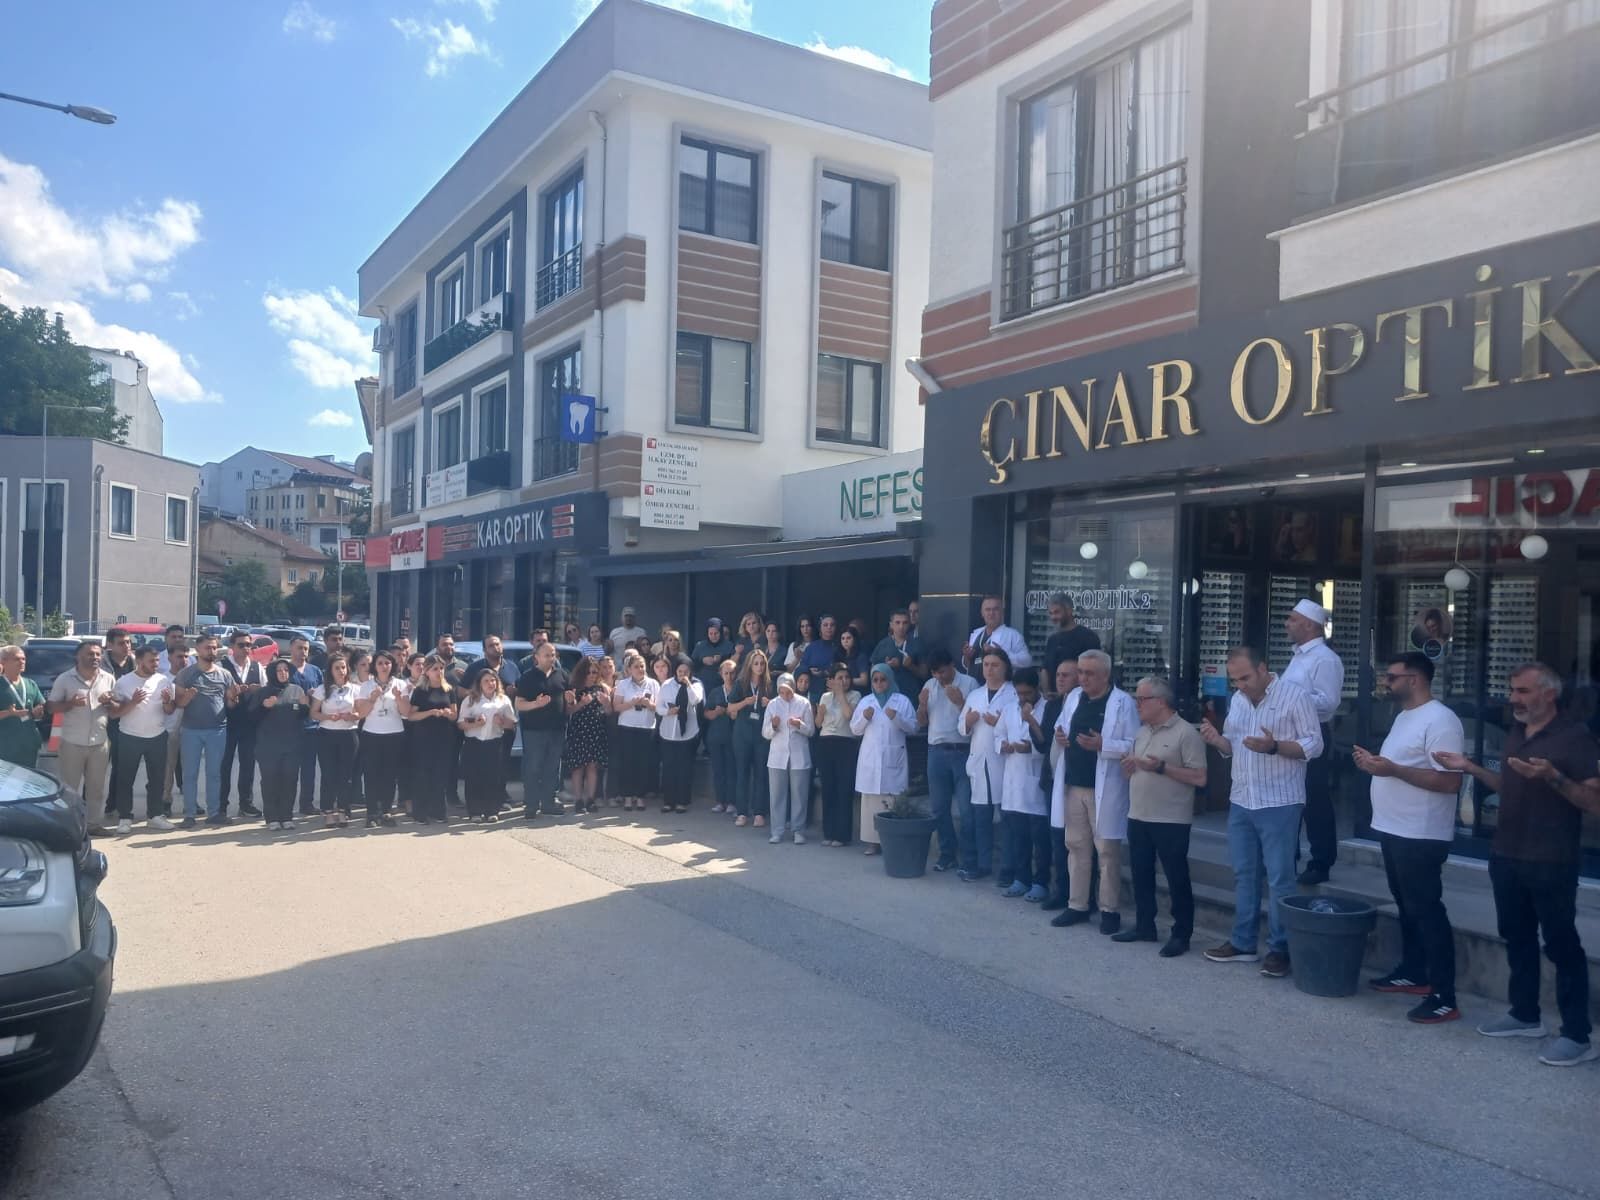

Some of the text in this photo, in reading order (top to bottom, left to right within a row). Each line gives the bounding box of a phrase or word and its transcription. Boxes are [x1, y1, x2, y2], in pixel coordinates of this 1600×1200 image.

[980, 264, 1600, 484] ÇINAR OPTİK
[840, 467, 924, 520] NEFES
[477, 509, 545, 549] KAR OPTIK
[346, 543, 357, 557] E
[1026, 584, 1151, 614] ÇINR OPTİK 2
